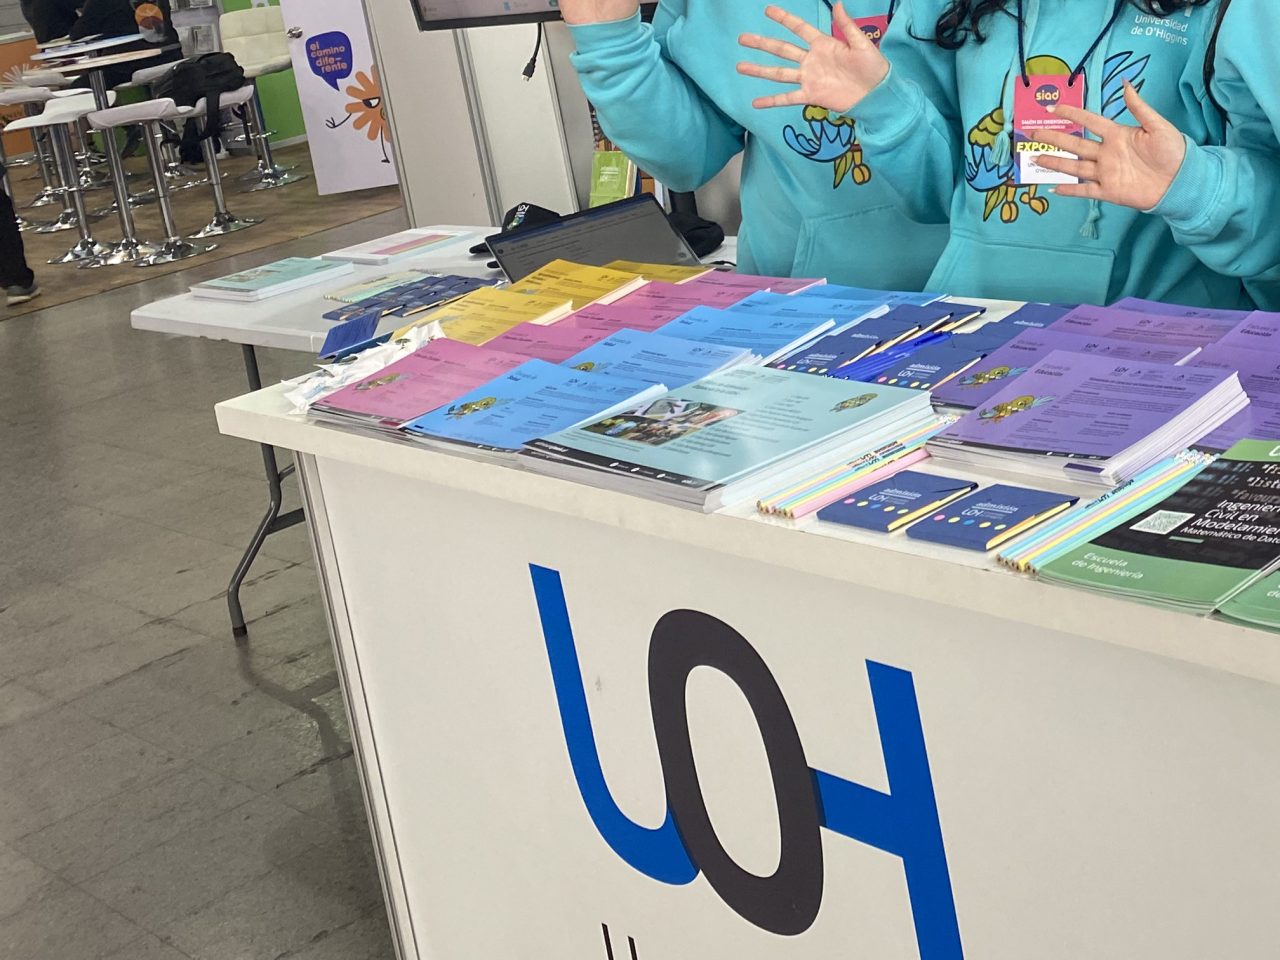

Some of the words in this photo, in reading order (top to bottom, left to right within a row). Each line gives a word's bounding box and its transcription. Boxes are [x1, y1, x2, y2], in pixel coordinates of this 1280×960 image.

[1135, 15, 1188, 33] Universidad
[1131, 26, 1143, 35] de
[1145, 26, 1188, 46] O'Higgins
[1036, 90, 1059, 101] siad
[1204, 509, 1239, 521] Civil
[1238, 513, 1259, 522] en
[1180, 526, 1242, 539] Matemático
[1242, 533, 1257, 541] de
[1083, 552, 1128, 567] Escuela
[1071, 560, 1087, 568] de
[1087, 563, 1144, 579] Ingeniería
